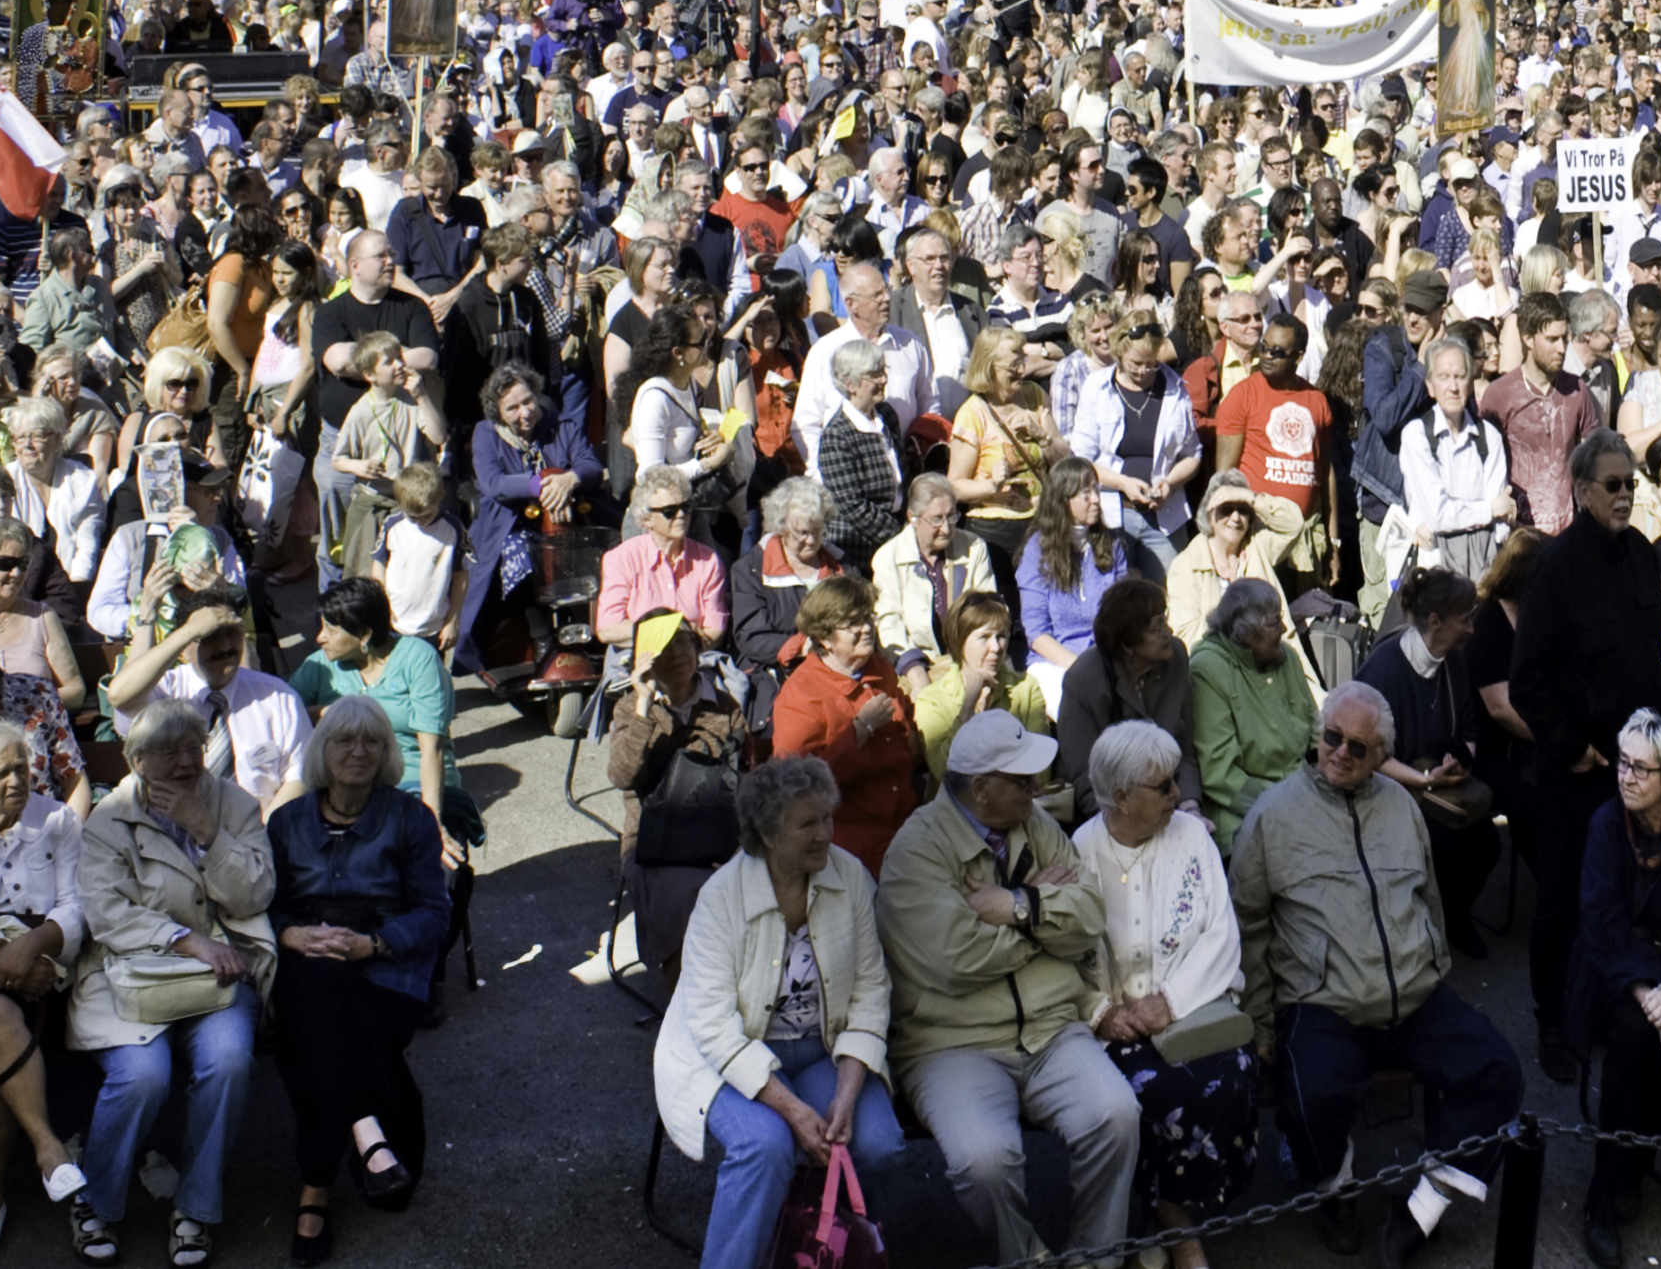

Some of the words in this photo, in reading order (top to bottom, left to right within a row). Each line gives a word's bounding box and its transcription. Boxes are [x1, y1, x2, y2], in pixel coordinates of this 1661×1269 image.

[1218, 9, 1275, 43] Jesus
[1278, 31, 1316, 46] sa:
[1564, 149, 1577, 168] Vi
[1580, 149, 1605, 168] Tror
[1609, 146, 1625, 167] På
[1566, 173, 1626, 203] JESUS
